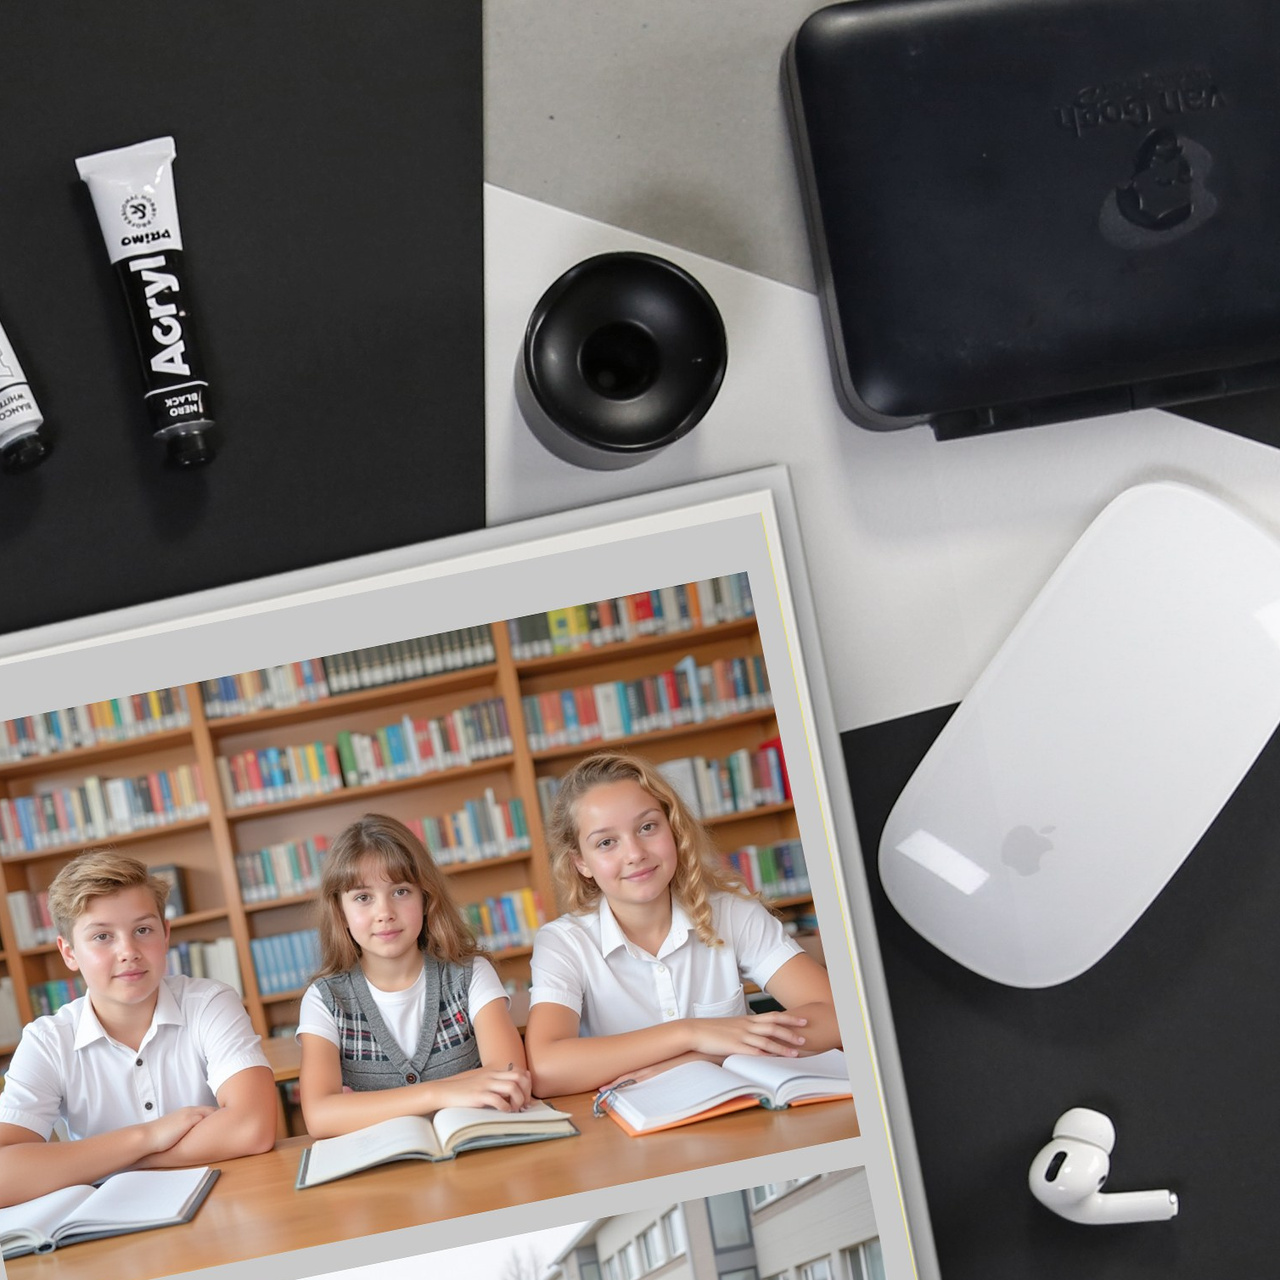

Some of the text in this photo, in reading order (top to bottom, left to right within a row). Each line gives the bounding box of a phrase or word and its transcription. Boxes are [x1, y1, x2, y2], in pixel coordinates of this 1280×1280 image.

[129, 255, 191, 376] Acryl
[165, 393, 199, 408] BLACK
[169, 403, 198, 417] NERO
